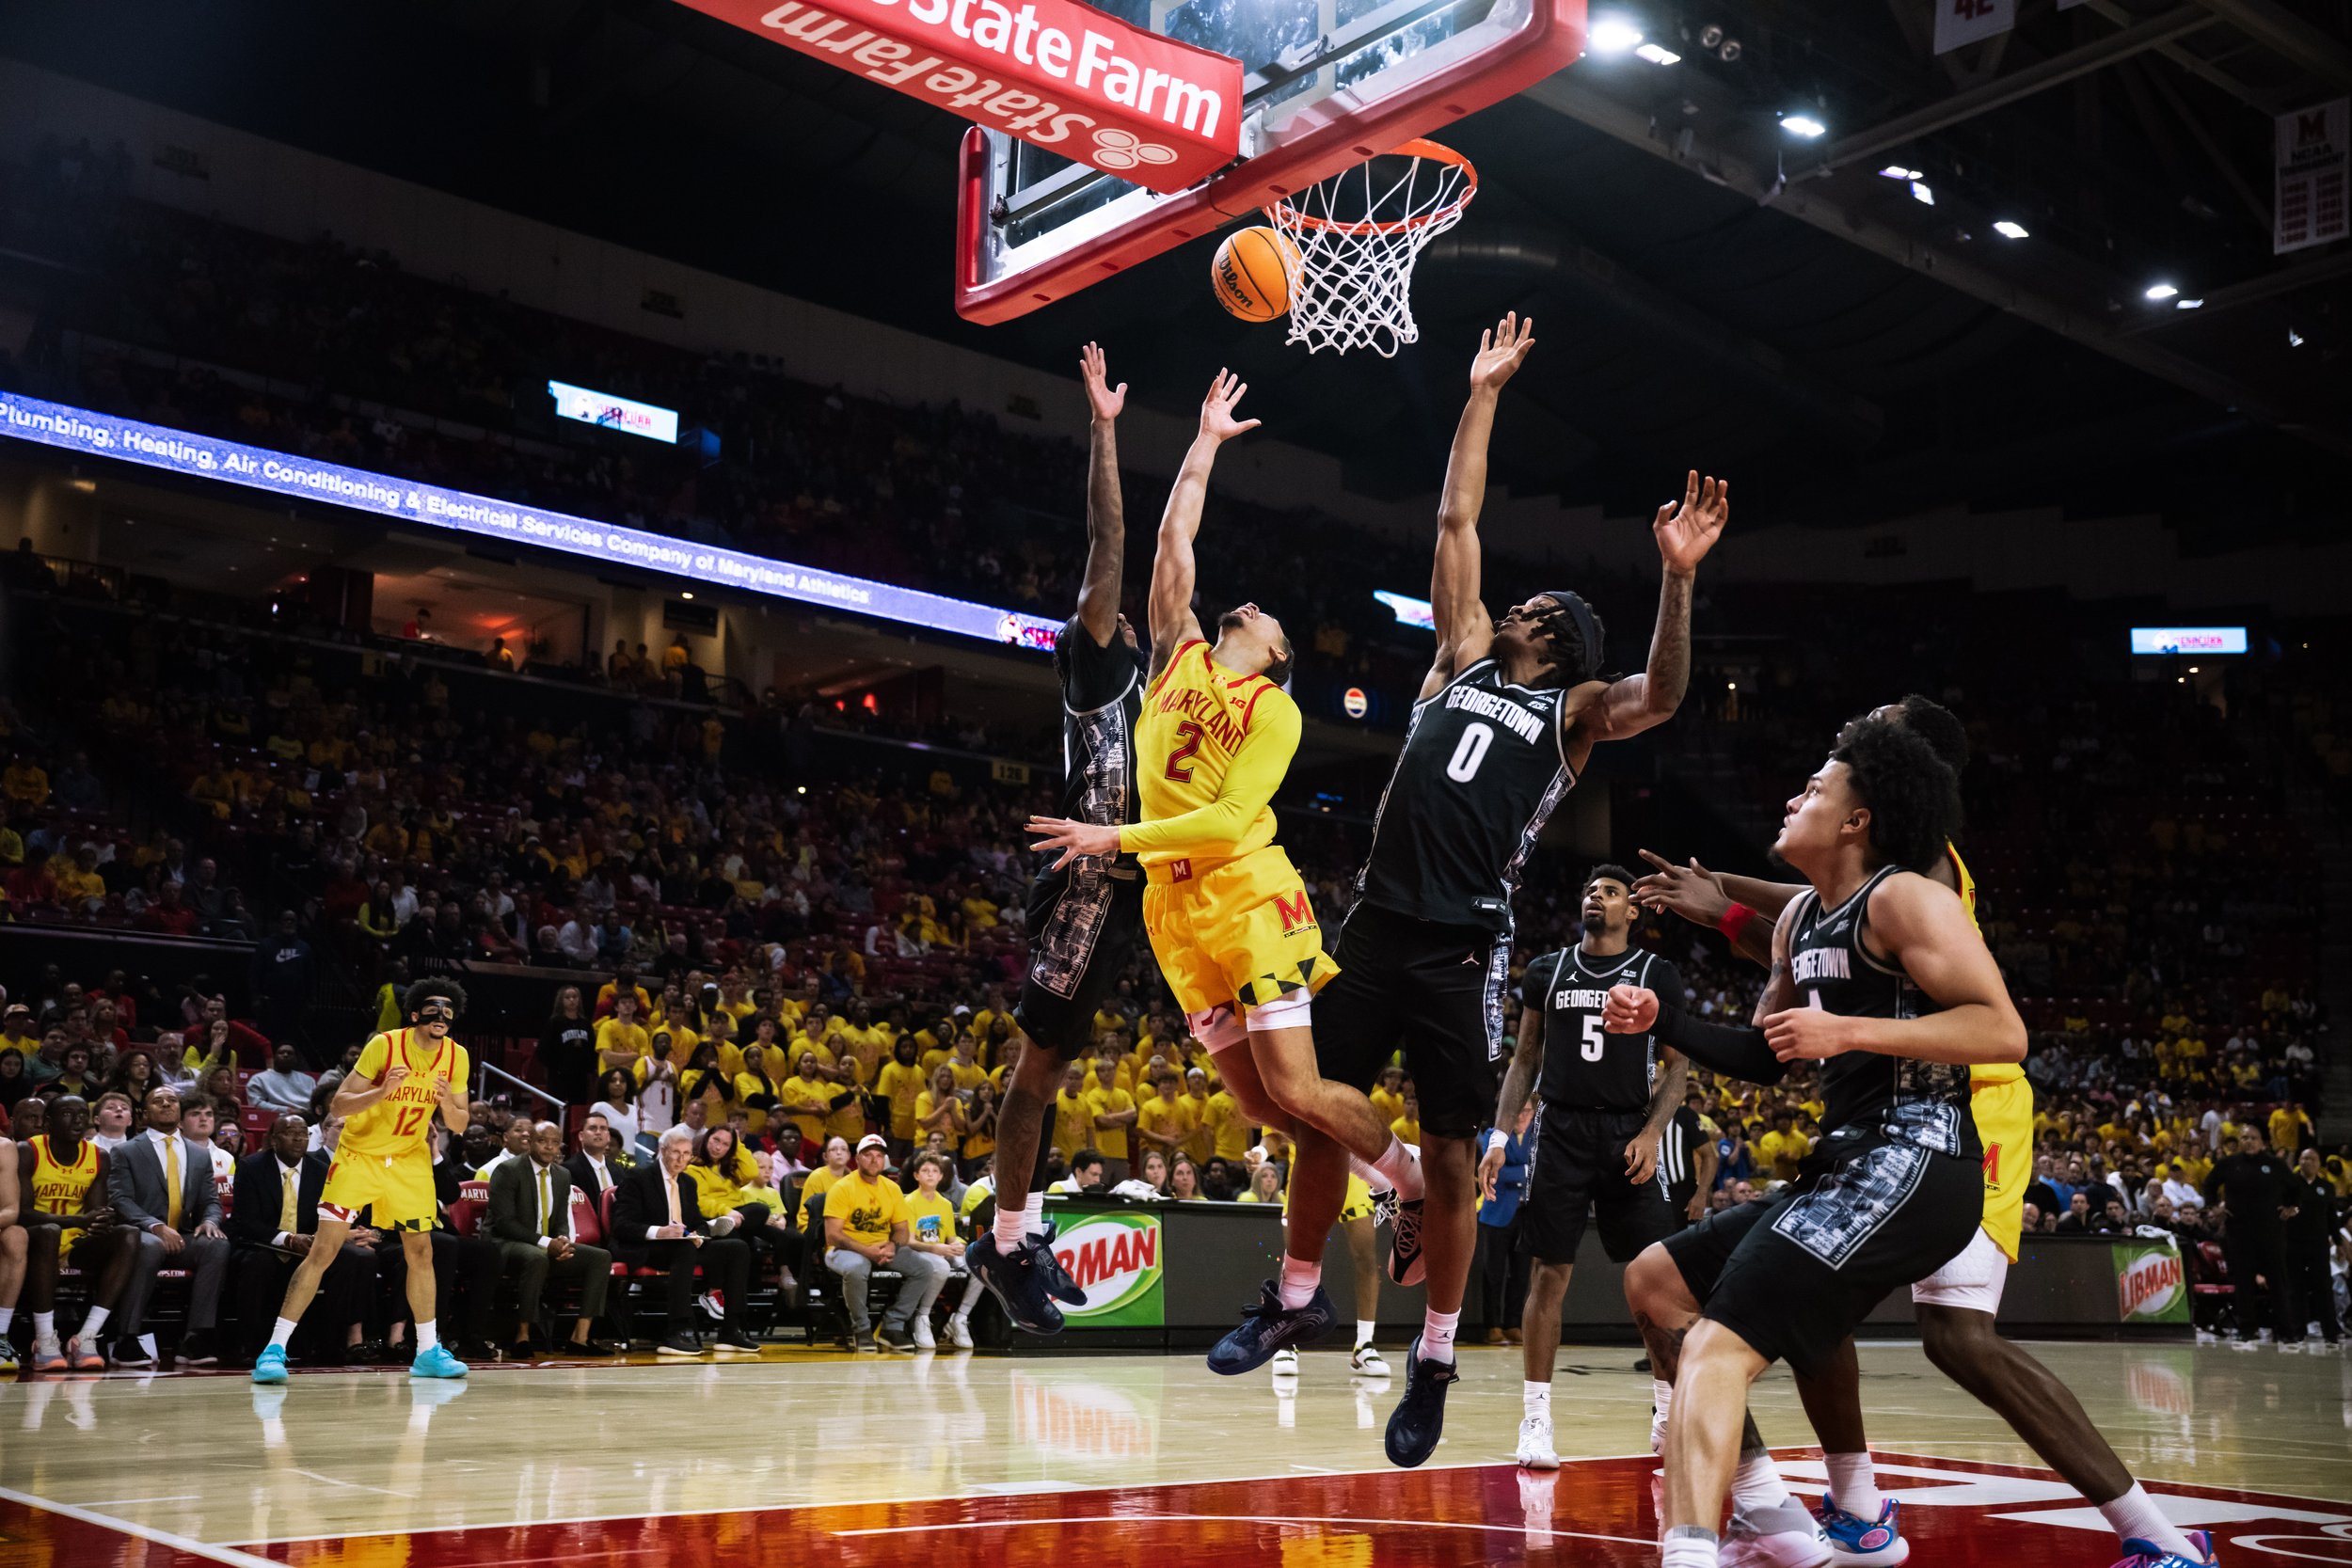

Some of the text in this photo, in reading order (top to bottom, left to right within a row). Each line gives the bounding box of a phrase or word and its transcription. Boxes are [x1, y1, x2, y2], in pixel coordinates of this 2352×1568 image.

[1218, 249, 1253, 309] Wilson
[123, 429, 218, 468] Heating,
[224, 452, 259, 474] Air
[263, 461, 400, 509] Conditioning
[405, 490, 421, 510] &
[427, 496, 517, 530] Electrical
[522, 515, 603, 548] Services
[607, 534, 693, 569] Company
[696, 552, 716, 572] of
[718, 556, 796, 589] Maryland
[798, 575, 871, 605] Athletics
[1158, 688, 1246, 757] MARYLAND
[1445, 685, 1547, 746] GEORGETOWN
[1164, 721, 1205, 784] 2
[1446, 721, 1495, 784] 0
[1173, 862, 1187, 877] M
[1270, 889, 1317, 934] M
[1555, 989, 1611, 1010] GEORGET
[1581, 1014, 1604, 1062] 5
[391, 1105, 425, 1137] 12
[460, 1188, 490, 1200] MARYL
[1054, 1227, 1157, 1290] BMAN
[2119, 1256, 2183, 1319] LIBMAN
